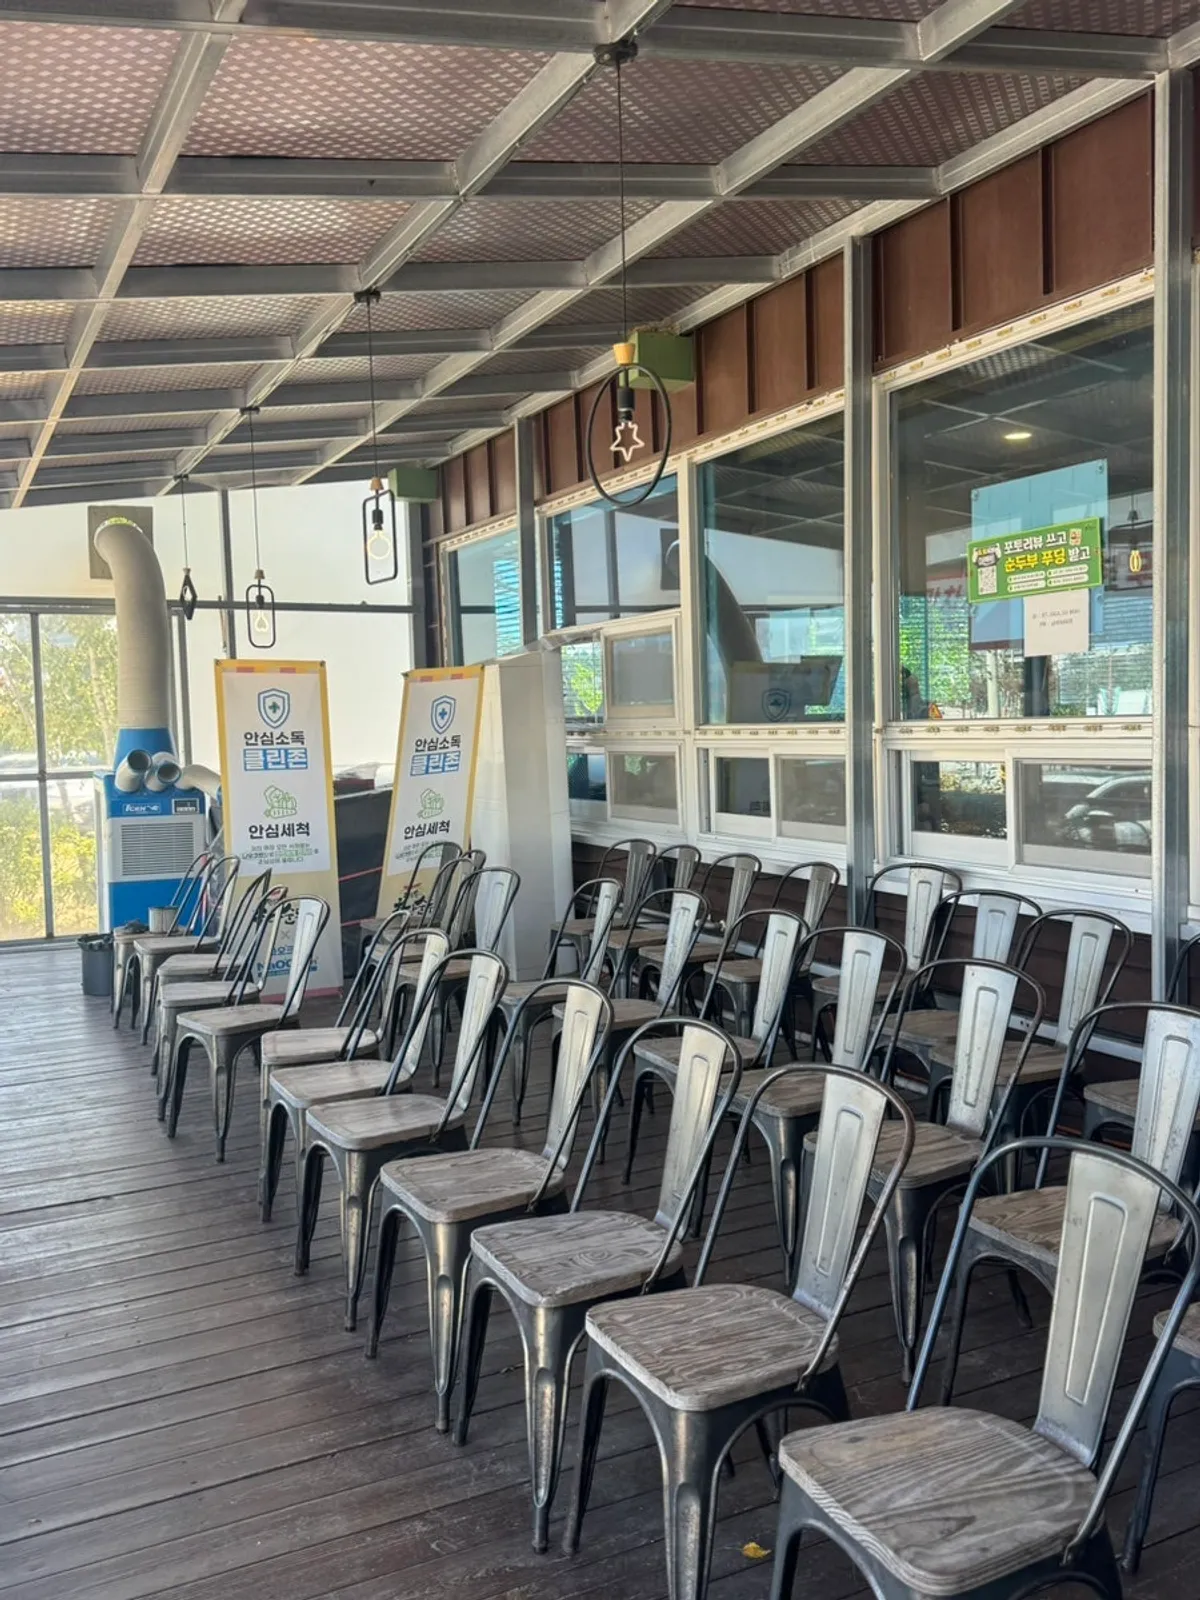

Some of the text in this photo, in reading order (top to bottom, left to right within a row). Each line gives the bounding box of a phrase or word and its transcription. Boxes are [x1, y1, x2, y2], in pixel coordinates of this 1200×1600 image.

[1004, 531, 1067, 554] 포토리뷰 쓰고
[1005, 552, 1038, 572] 순두부
[1041, 547, 1066, 566] 푸딩
[1068, 546, 1090, 562] 받고
[244, 730, 306, 746] 안심소독
[415, 734, 461, 753] 안심소독
[243, 747, 308, 771] 클린존
[410, 750, 461, 776] 클린존
[248, 822, 311, 840] 안심세척
[404, 819, 450, 840] 안심세척
